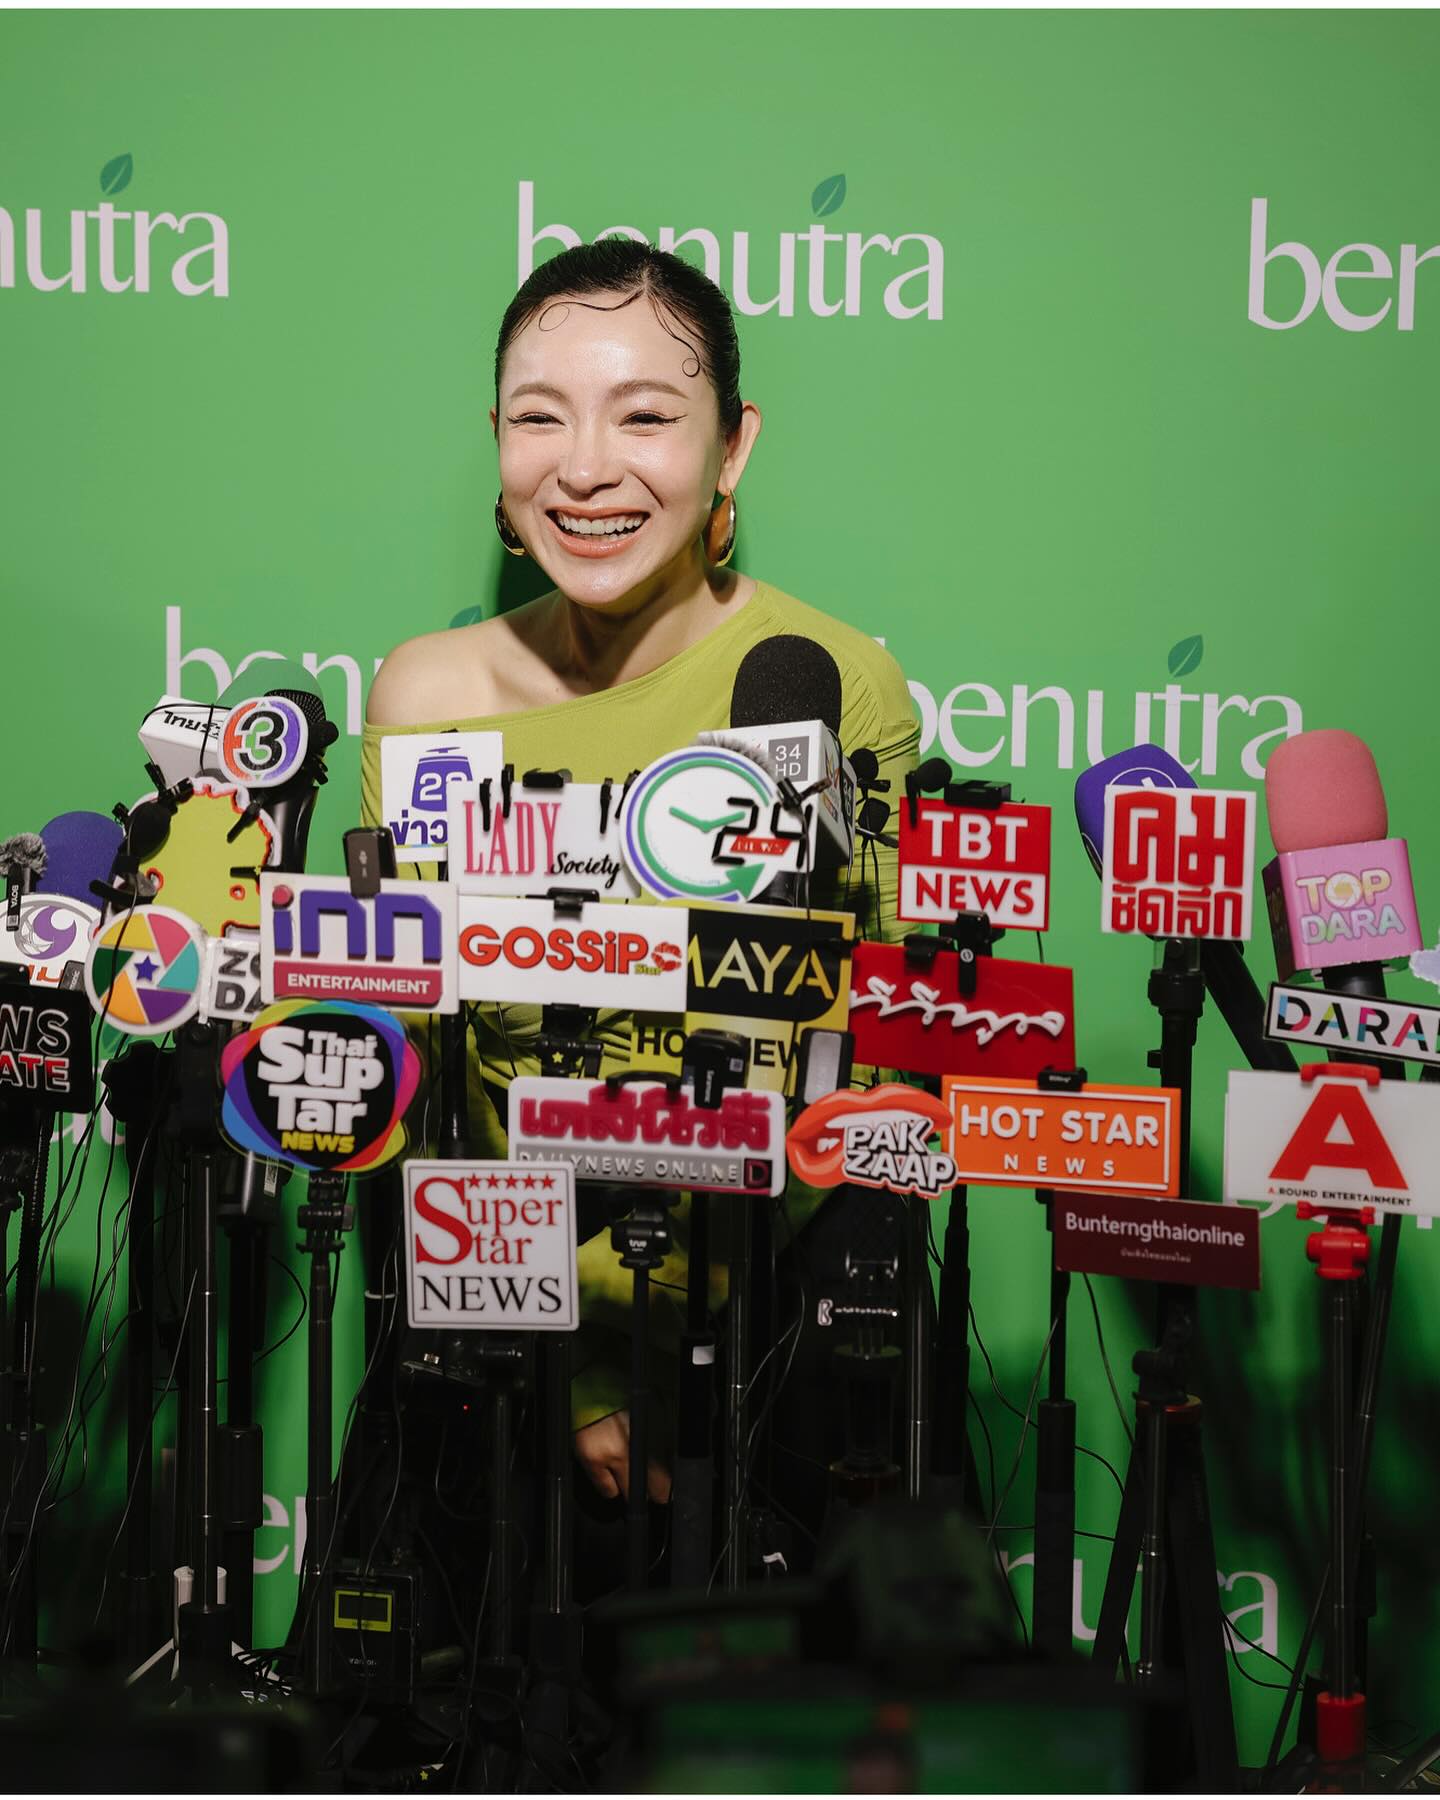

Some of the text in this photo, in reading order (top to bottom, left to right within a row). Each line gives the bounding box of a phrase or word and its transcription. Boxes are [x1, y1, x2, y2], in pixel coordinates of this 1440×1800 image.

[240, 710, 287, 772] 3
[774, 743, 802, 762] 34
[774, 763, 802, 777] HD
[463, 800, 563, 877] LADY
[711, 797, 814, 870] 24
[921, 810, 1028, 863] TBT
[1113, 791, 1246, 888] คม
[551, 851, 623, 889] Society
[916, 872, 1034, 916] NEWS
[1296, 867, 1392, 915] TOP
[272, 884, 443, 965] inn
[1301, 904, 1406, 946] DARA
[287, 973, 431, 995] ENTERTAINMENT
[635, 963, 662, 977] Star
[307, 1030, 378, 1057] Thai
[281, 1130, 356, 1154] NEWS
[847, 1118, 932, 1154] PAK
[960, 1103, 1159, 1148] HOT STAR
[1268, 1083, 1409, 1190] A
[655, 1162, 738, 1183] ONLINE
[846, 1149, 955, 1190] ZAAP
[1003, 1153, 1115, 1178] NEWS
[1322, 1190, 1412, 1207] ENTERTAINMENT
[1065, 1211, 1246, 1247] Bunterngthaionline
[417, 1275, 562, 1313] NEWS
